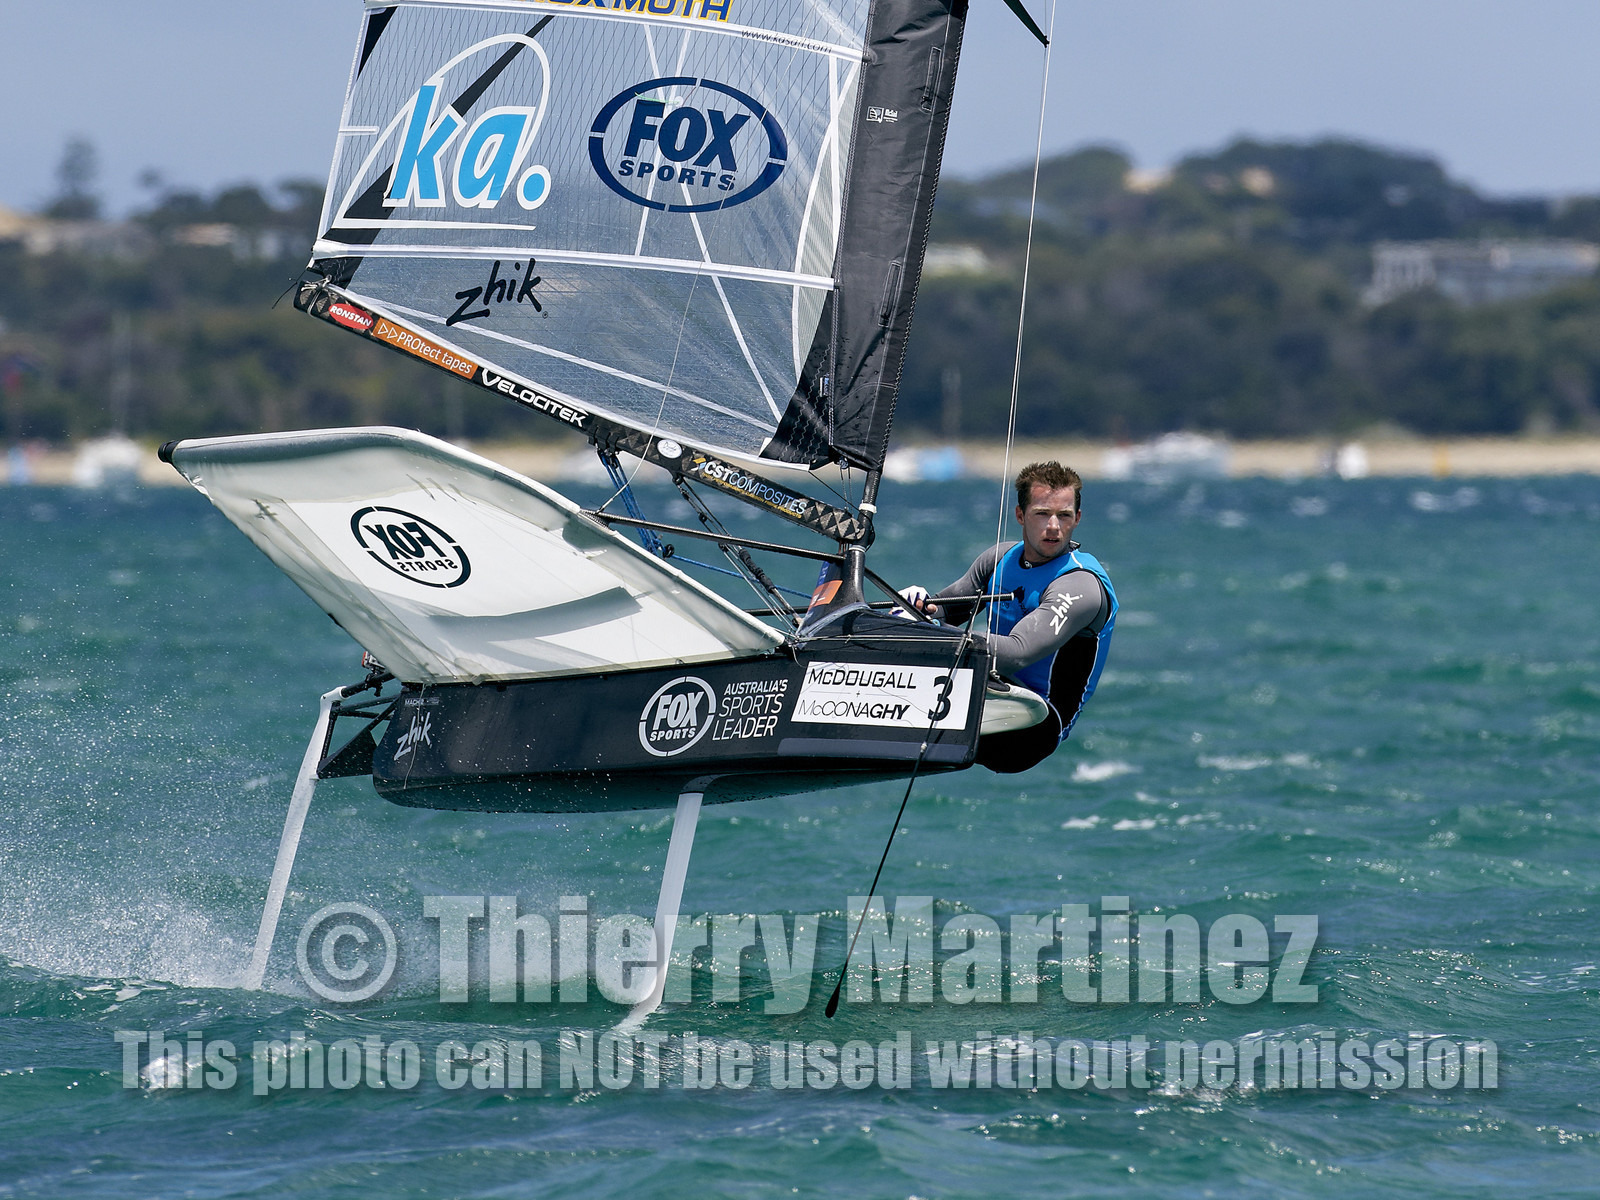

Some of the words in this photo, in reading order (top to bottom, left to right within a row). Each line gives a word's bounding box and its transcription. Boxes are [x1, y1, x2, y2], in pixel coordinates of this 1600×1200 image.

[624, 99, 751, 172] FOX
[618, 160, 736, 191] SPORTS
[329, 305, 372, 327] RONSTAN
[442, 351, 473, 375] tapes
[481, 367, 588, 427] VELOCITEK
[724, 679, 788, 696] AUSTRALIA'S
[808, 668, 917, 689] McDOUGALL
[928, 675, 954, 721] 3
[652, 691, 704, 730] FOX
[719, 693, 784, 717] SPORTS
[798, 700, 910, 720] McCONAGHY
[650, 727, 696, 742] SPORTS
[712, 715, 778, 741] LEADER
